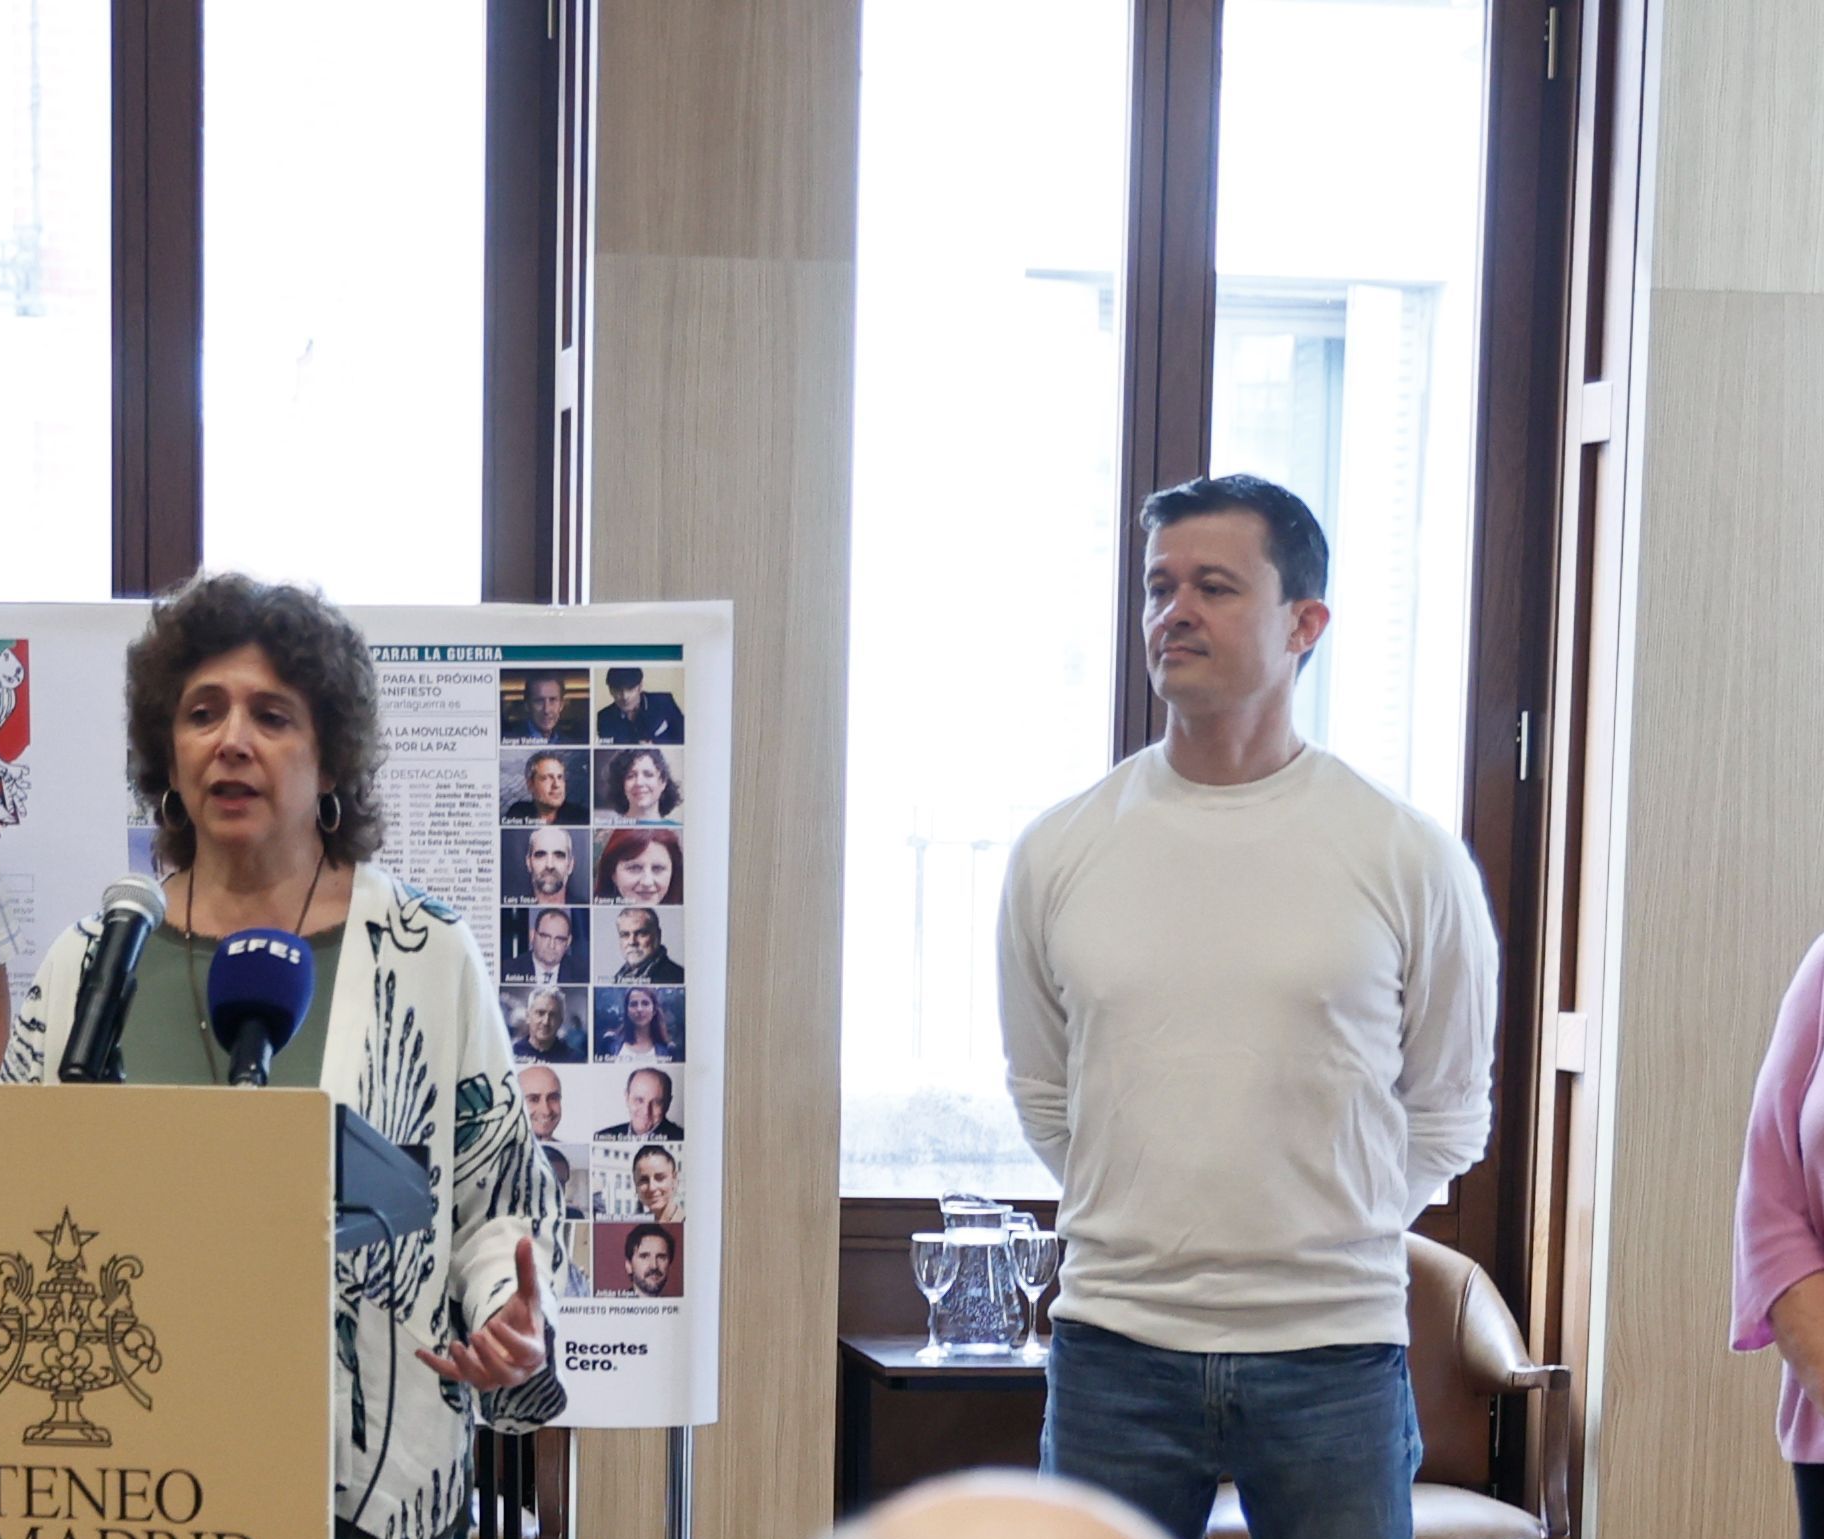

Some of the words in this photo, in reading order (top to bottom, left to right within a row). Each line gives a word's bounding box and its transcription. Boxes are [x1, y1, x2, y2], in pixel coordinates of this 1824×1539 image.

[372, 647, 419, 661] PARAR
[424, 647, 441, 661] LA
[446, 647, 503, 661] GUERRA
[383, 674, 416, 684] PARA
[419, 674, 433, 684] EL
[437, 672, 493, 684] PRÓXIMO
[379, 686, 442, 697] ANIFIESTO
[395, 727, 408, 737] LA
[411, 725, 488, 737] MOVILIZACIÓN
[395, 742, 418, 752] POR
[420, 742, 434, 752] LA
[436, 742, 457, 752] PAZ
[391, 769, 468, 780] DESTACADAS
[609, 1306, 660, 1315] PROMOVIDO
[565, 1341, 648, 1356] Recortes
[565, 1356, 618, 1371] Cero.
